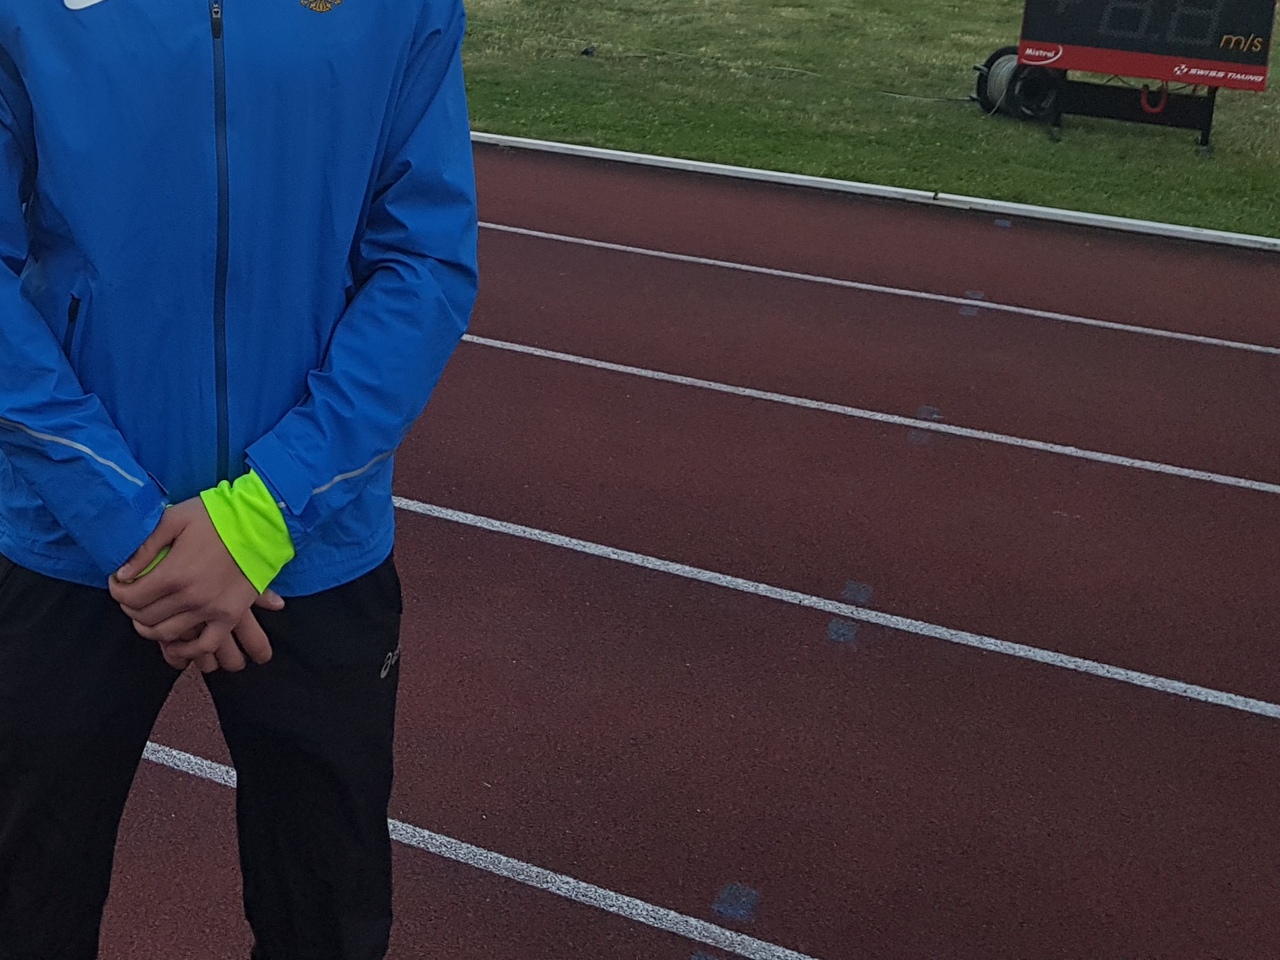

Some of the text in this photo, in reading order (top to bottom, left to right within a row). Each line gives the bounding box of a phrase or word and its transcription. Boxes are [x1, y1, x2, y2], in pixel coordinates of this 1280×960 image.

[1219, 33, 1263, 52] m/s
[1188, 68, 1265, 83] SWISS TIMING
